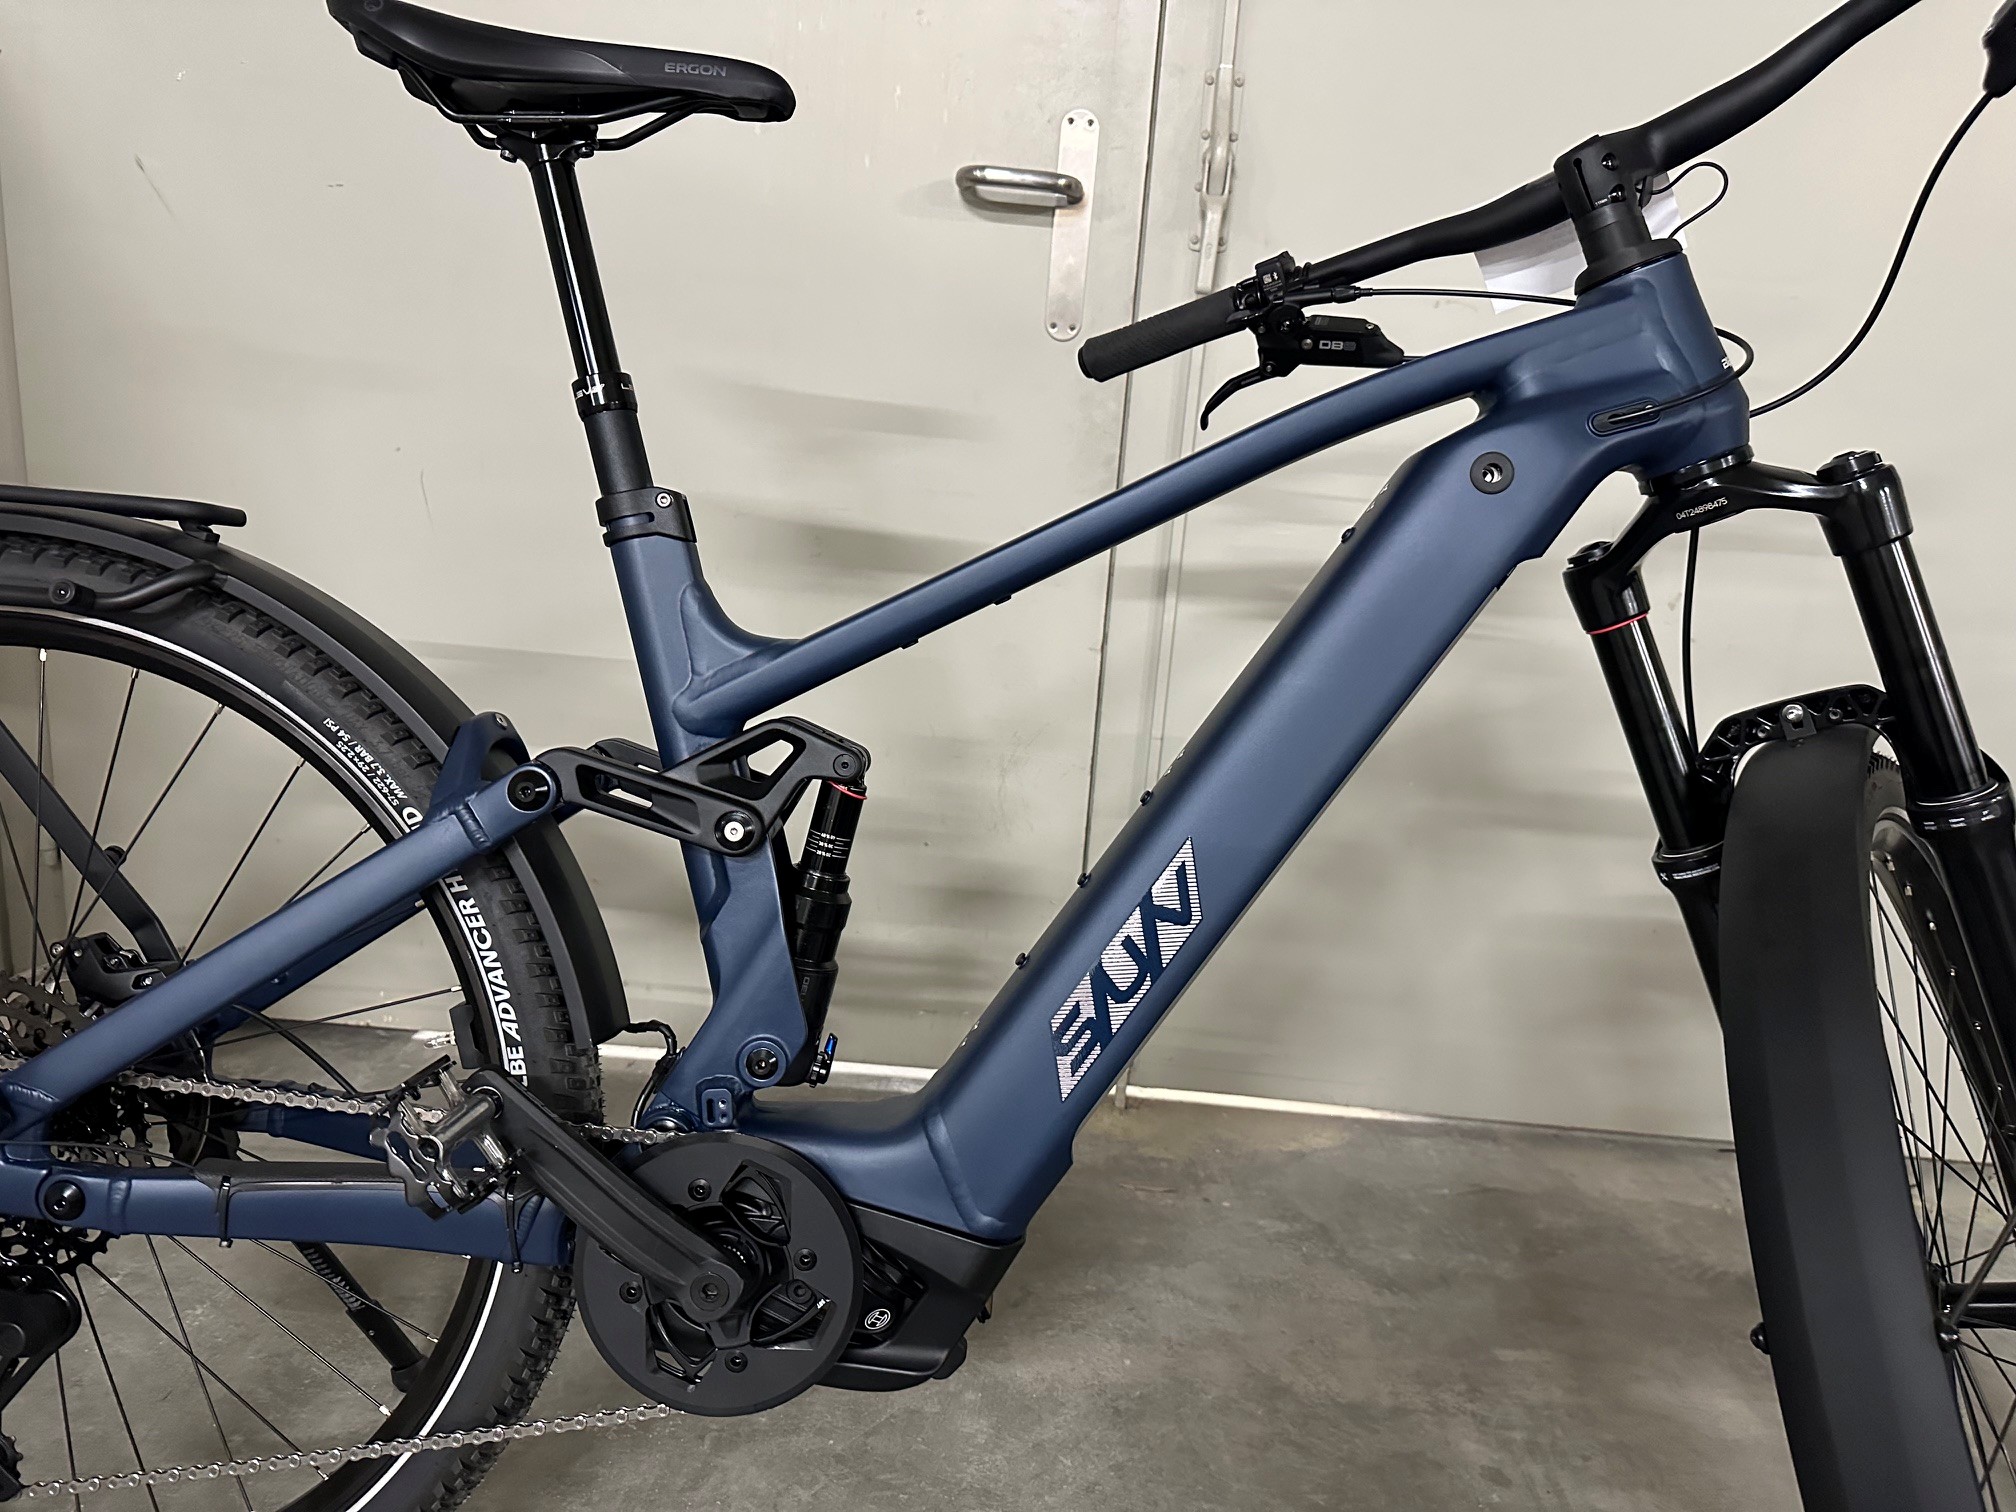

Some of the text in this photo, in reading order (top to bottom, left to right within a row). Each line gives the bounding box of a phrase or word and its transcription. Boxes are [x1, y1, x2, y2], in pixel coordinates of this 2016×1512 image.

[664, 62, 727, 77] ERGON
[322, 717, 340, 732] PSI
[337, 729, 351, 743] 54
[354, 744, 374, 763] BAR
[371, 762, 386, 776] 3.7
[373, 776, 400, 807] 57-622
[383, 774, 408, 800] MAX.
[458, 896, 523, 1041] ADVANCER
